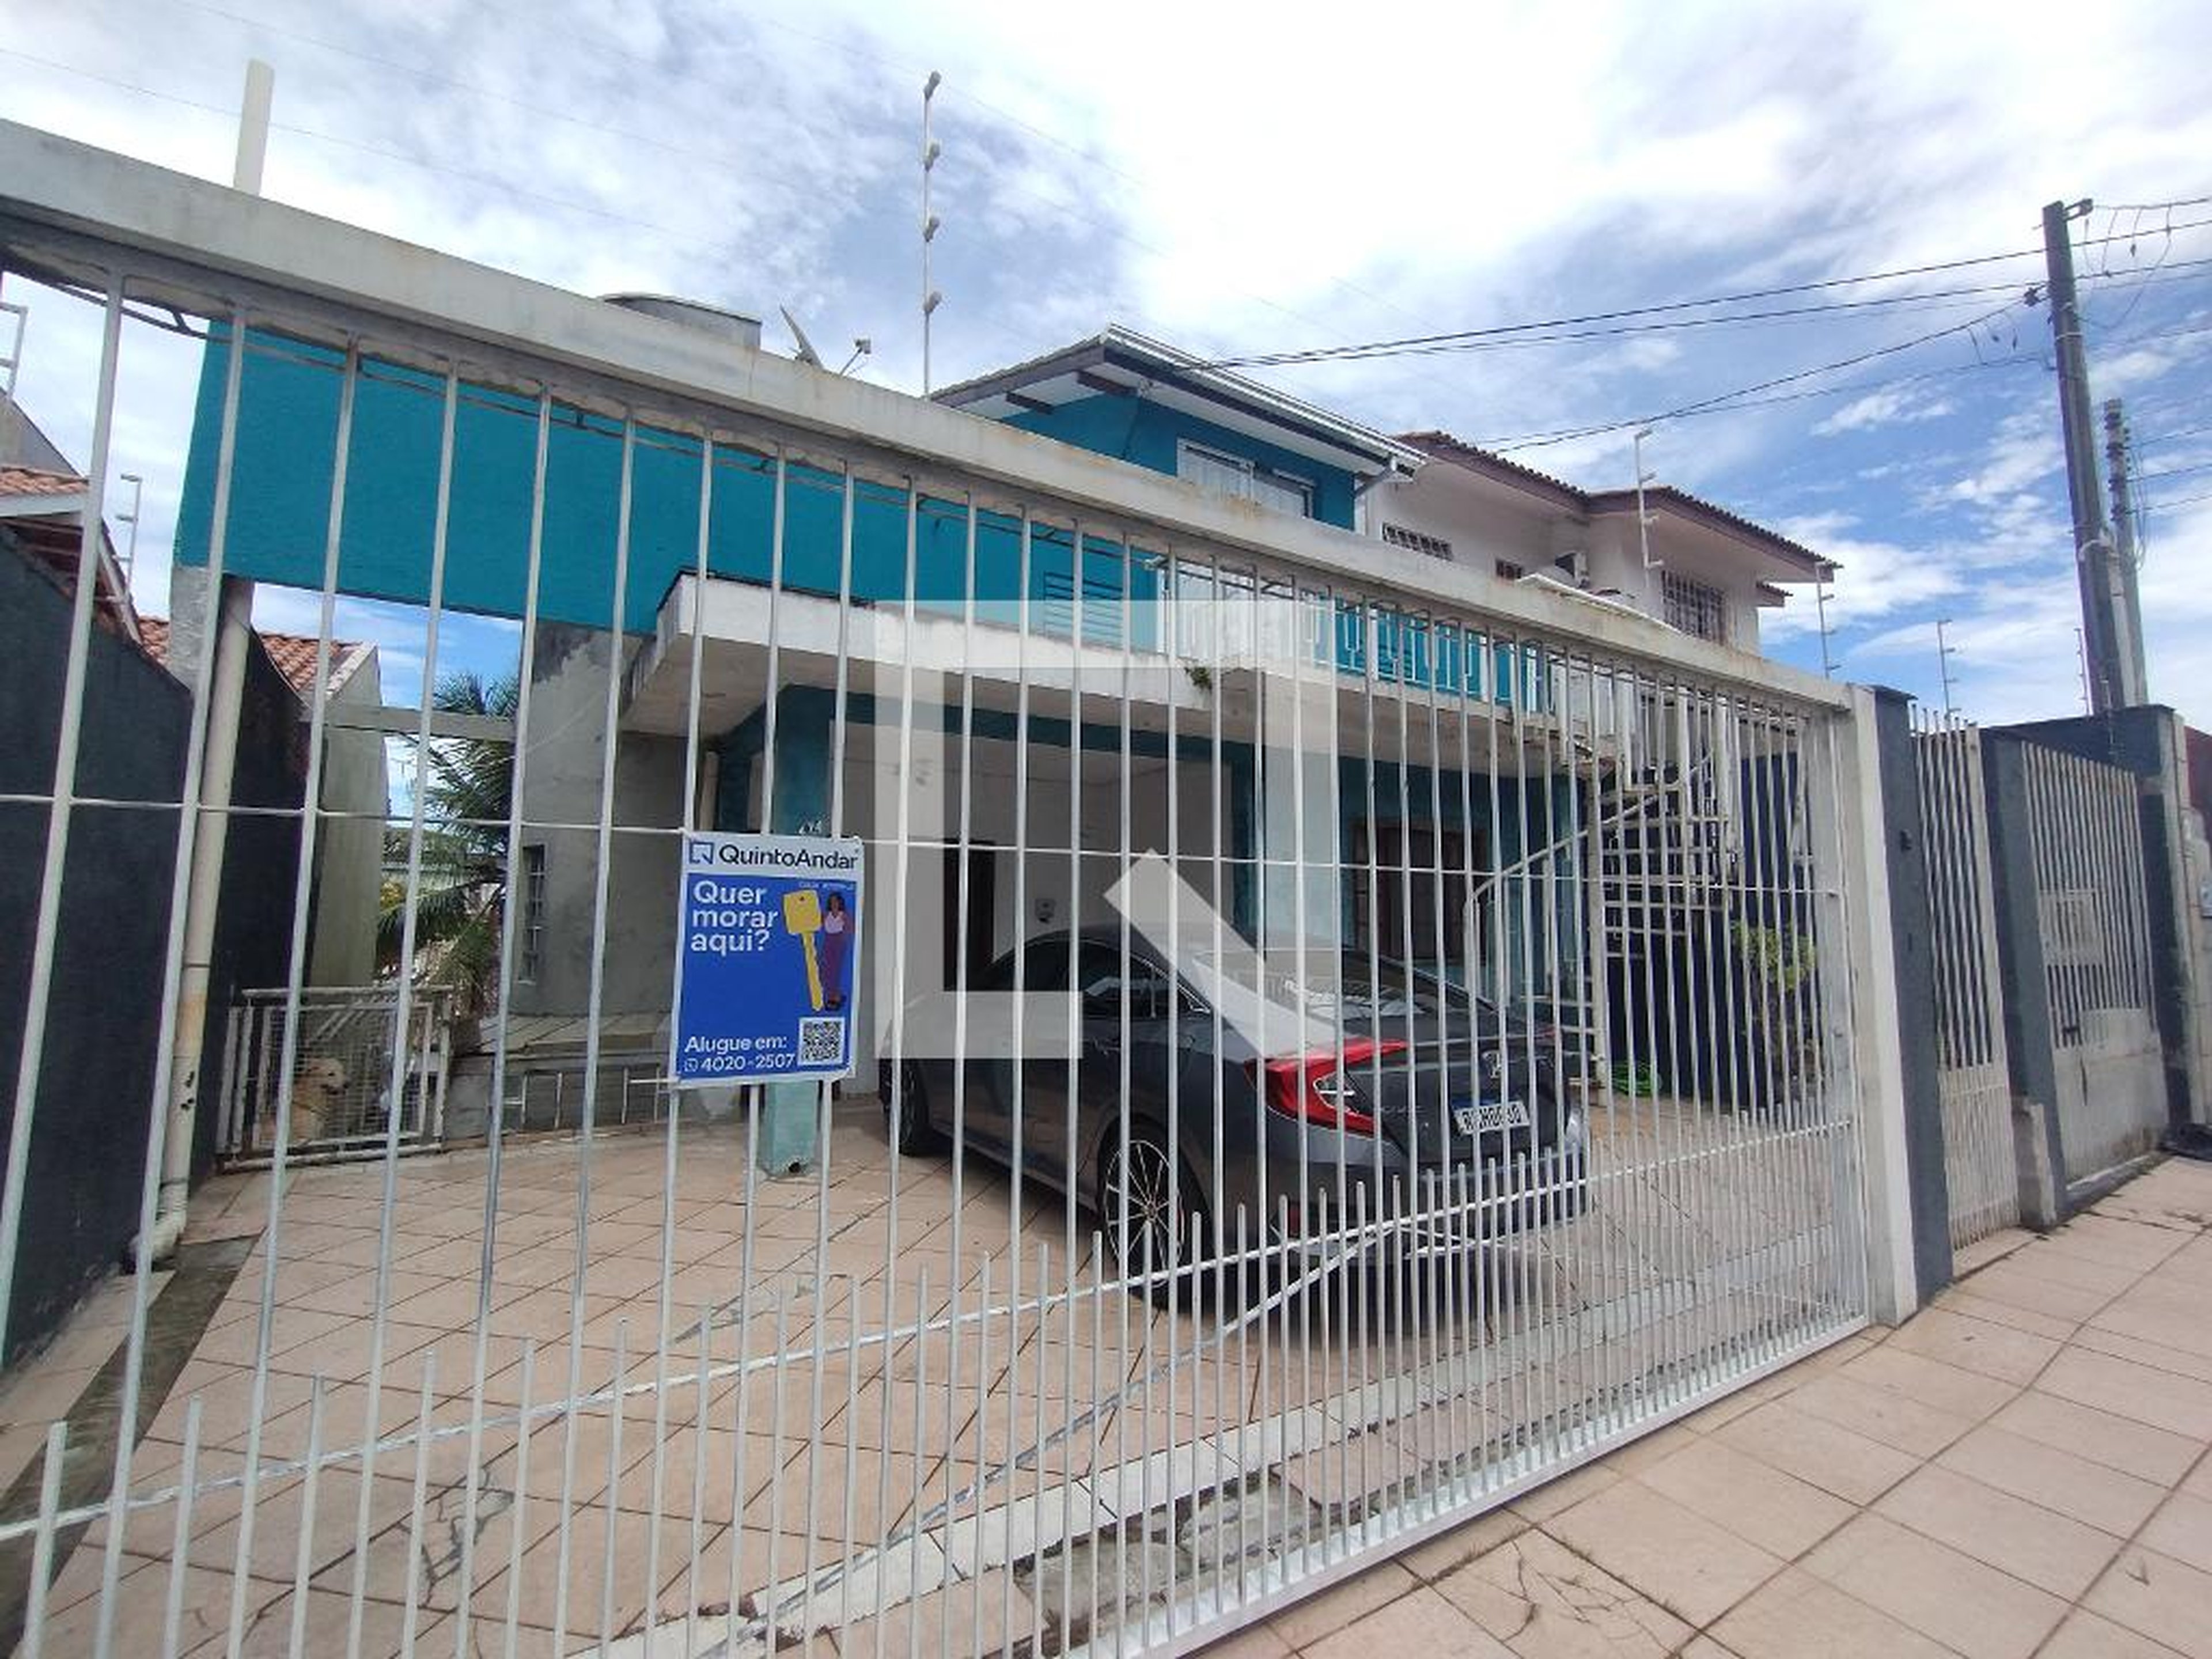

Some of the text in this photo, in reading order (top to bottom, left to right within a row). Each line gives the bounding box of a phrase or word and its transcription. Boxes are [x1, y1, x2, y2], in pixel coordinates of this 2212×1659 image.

[719, 844, 858, 869] QuintoAndar
[694, 880, 767, 905] Quer
[692, 910, 778, 928] morar
[691, 929, 770, 956] aqui?
[684, 1036, 787, 1055] Alugue em:
